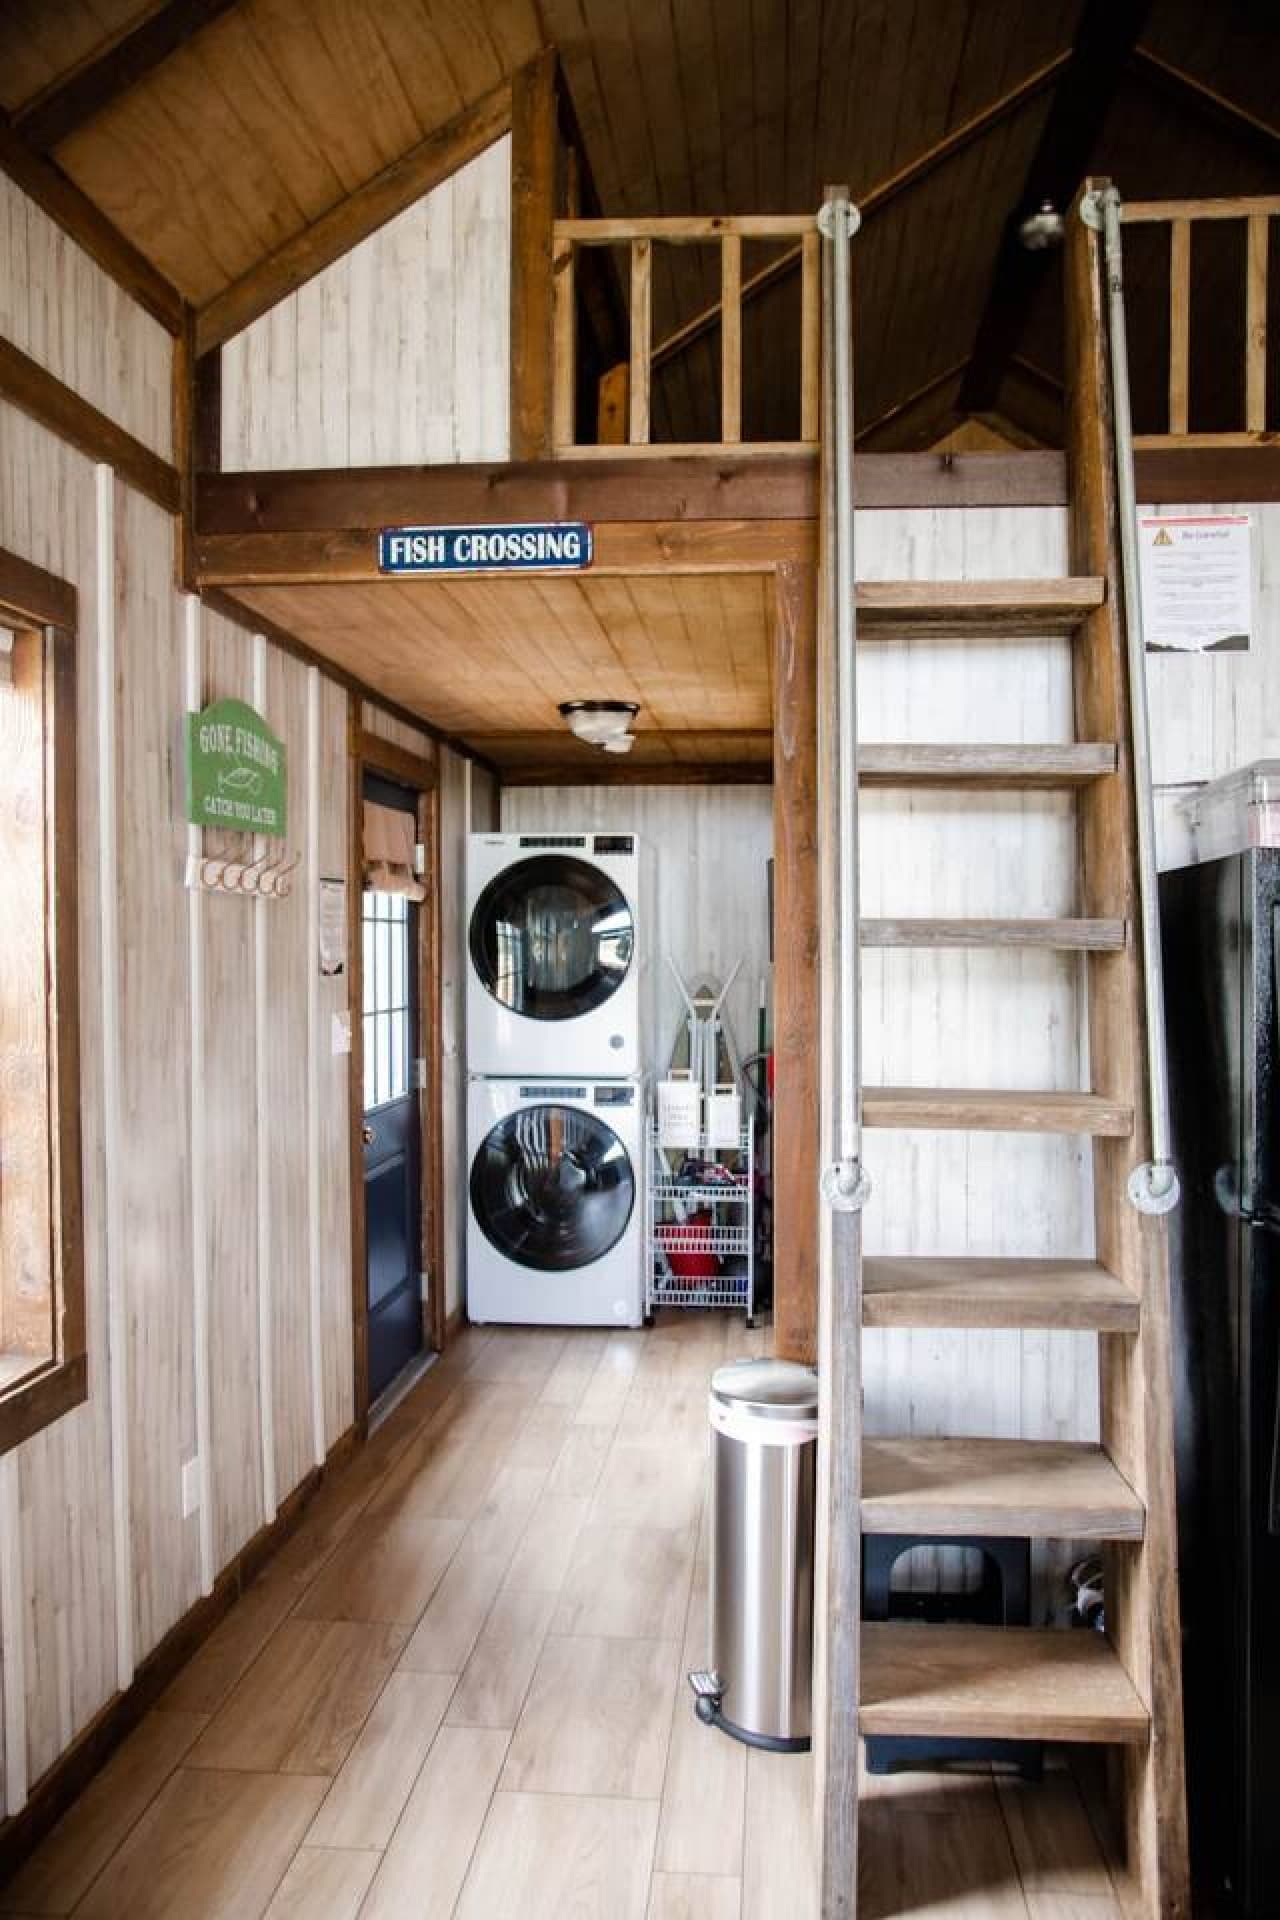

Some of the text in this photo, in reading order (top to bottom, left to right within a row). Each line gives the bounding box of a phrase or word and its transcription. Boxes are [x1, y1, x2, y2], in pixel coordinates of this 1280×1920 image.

[390, 531, 581, 564] FISH CROSSING
[200, 724, 279, 777] GONE FISHING
